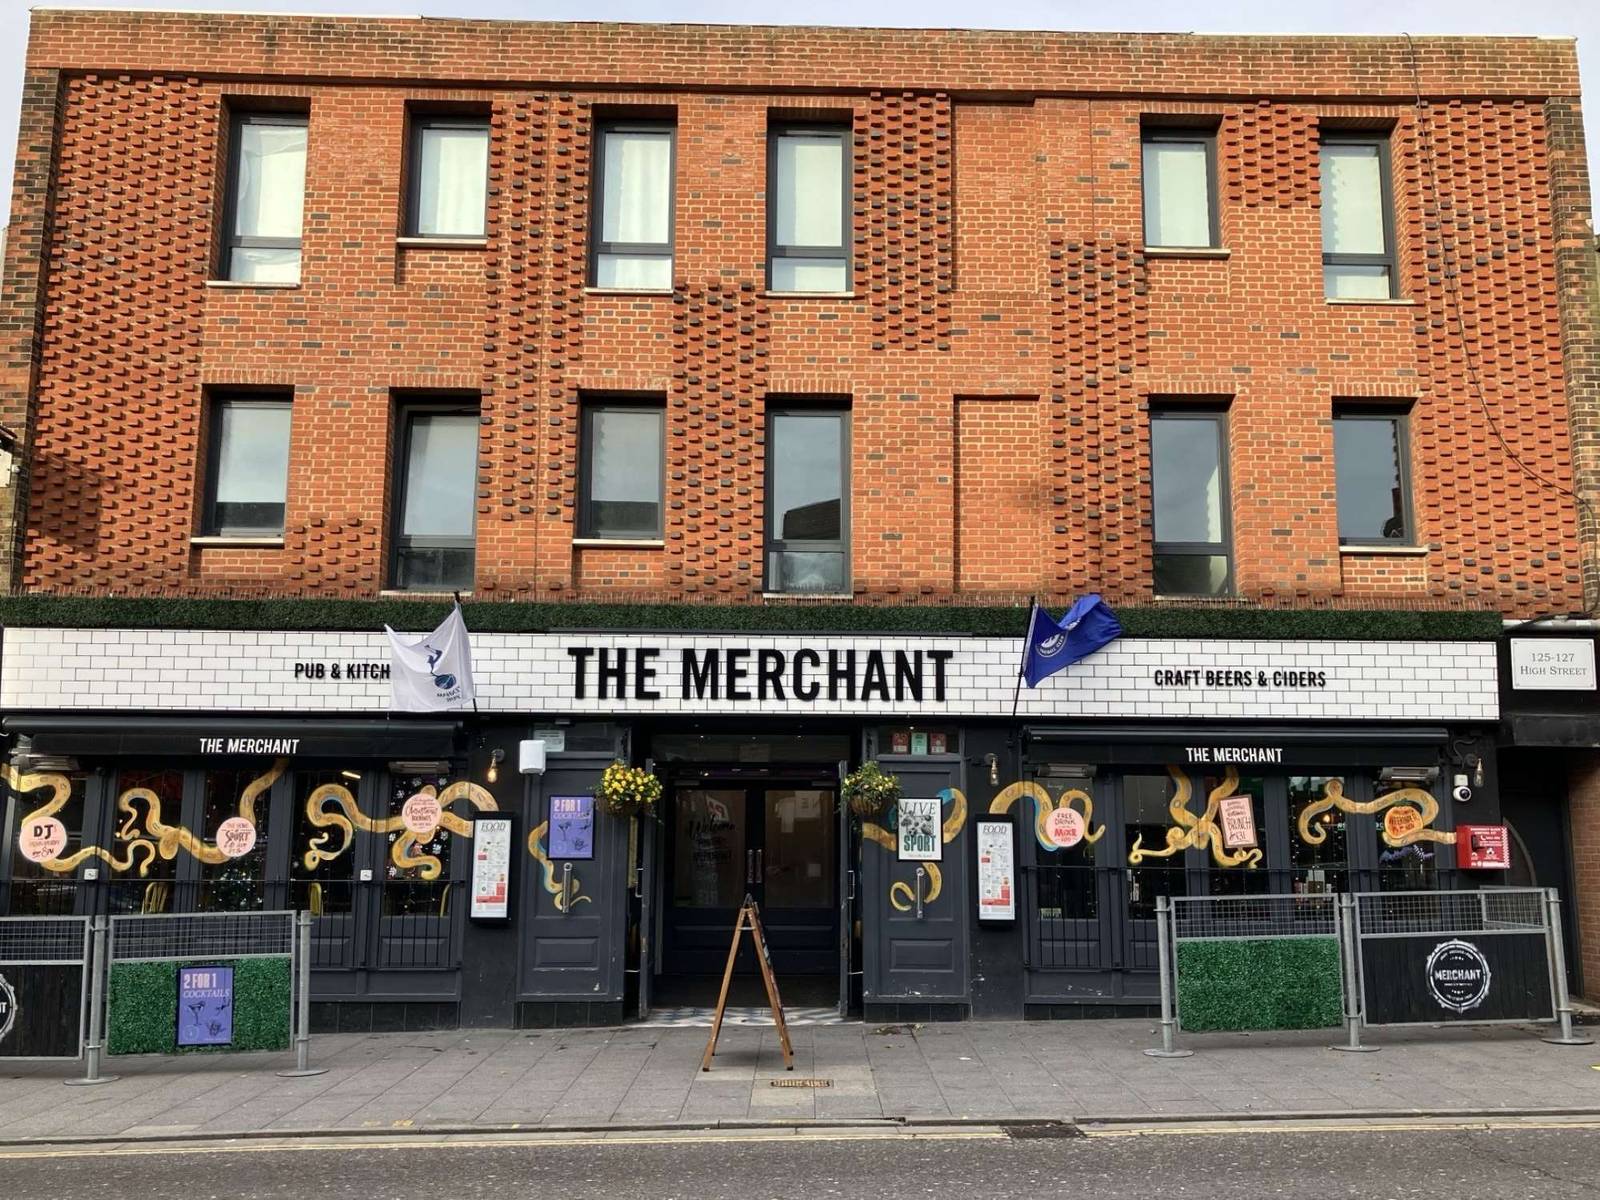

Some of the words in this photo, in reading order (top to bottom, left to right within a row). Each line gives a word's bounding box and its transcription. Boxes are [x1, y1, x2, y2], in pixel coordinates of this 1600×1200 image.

[1532, 652, 1575, 662] 125-127
[294, 662, 325, 679] PUB
[330, 662, 341, 679] &
[346, 663, 391, 680] KITCH
[568, 647, 660, 700] THE
[681, 648, 954, 702] MERCHANT
[1520, 665, 1546, 675] HIGH
[1550, 665, 1588, 676] STREET
[1154, 669, 1201, 686] CRAFT
[1205, 670, 1253, 687] BEERS
[1257, 670, 1268, 687] &
[1273, 671, 1326, 687] CIDERS
[200, 738, 224, 753] THE
[227, 738, 300, 754] MERCHANT
[1185, 747, 1210, 762] THE
[1213, 747, 1283, 763] MERCHANT
[554, 799, 560, 812] 2
[561, 799, 576, 812] FOR
[577, 799, 581, 812] 1
[904, 802, 938, 815] LIVE
[481, 822, 506, 833] FOOD
[1054, 818, 1076, 826] DRINK
[983, 824, 1008, 834] FOOD
[903, 834, 936, 852] SPORT
[183, 973, 191, 990] 2
[192, 973, 210, 989] FOR
[212, 973, 217, 988] 1
[1434, 969, 1481, 981] MERCHANT
[183, 987, 231, 998] COCKTAILS
